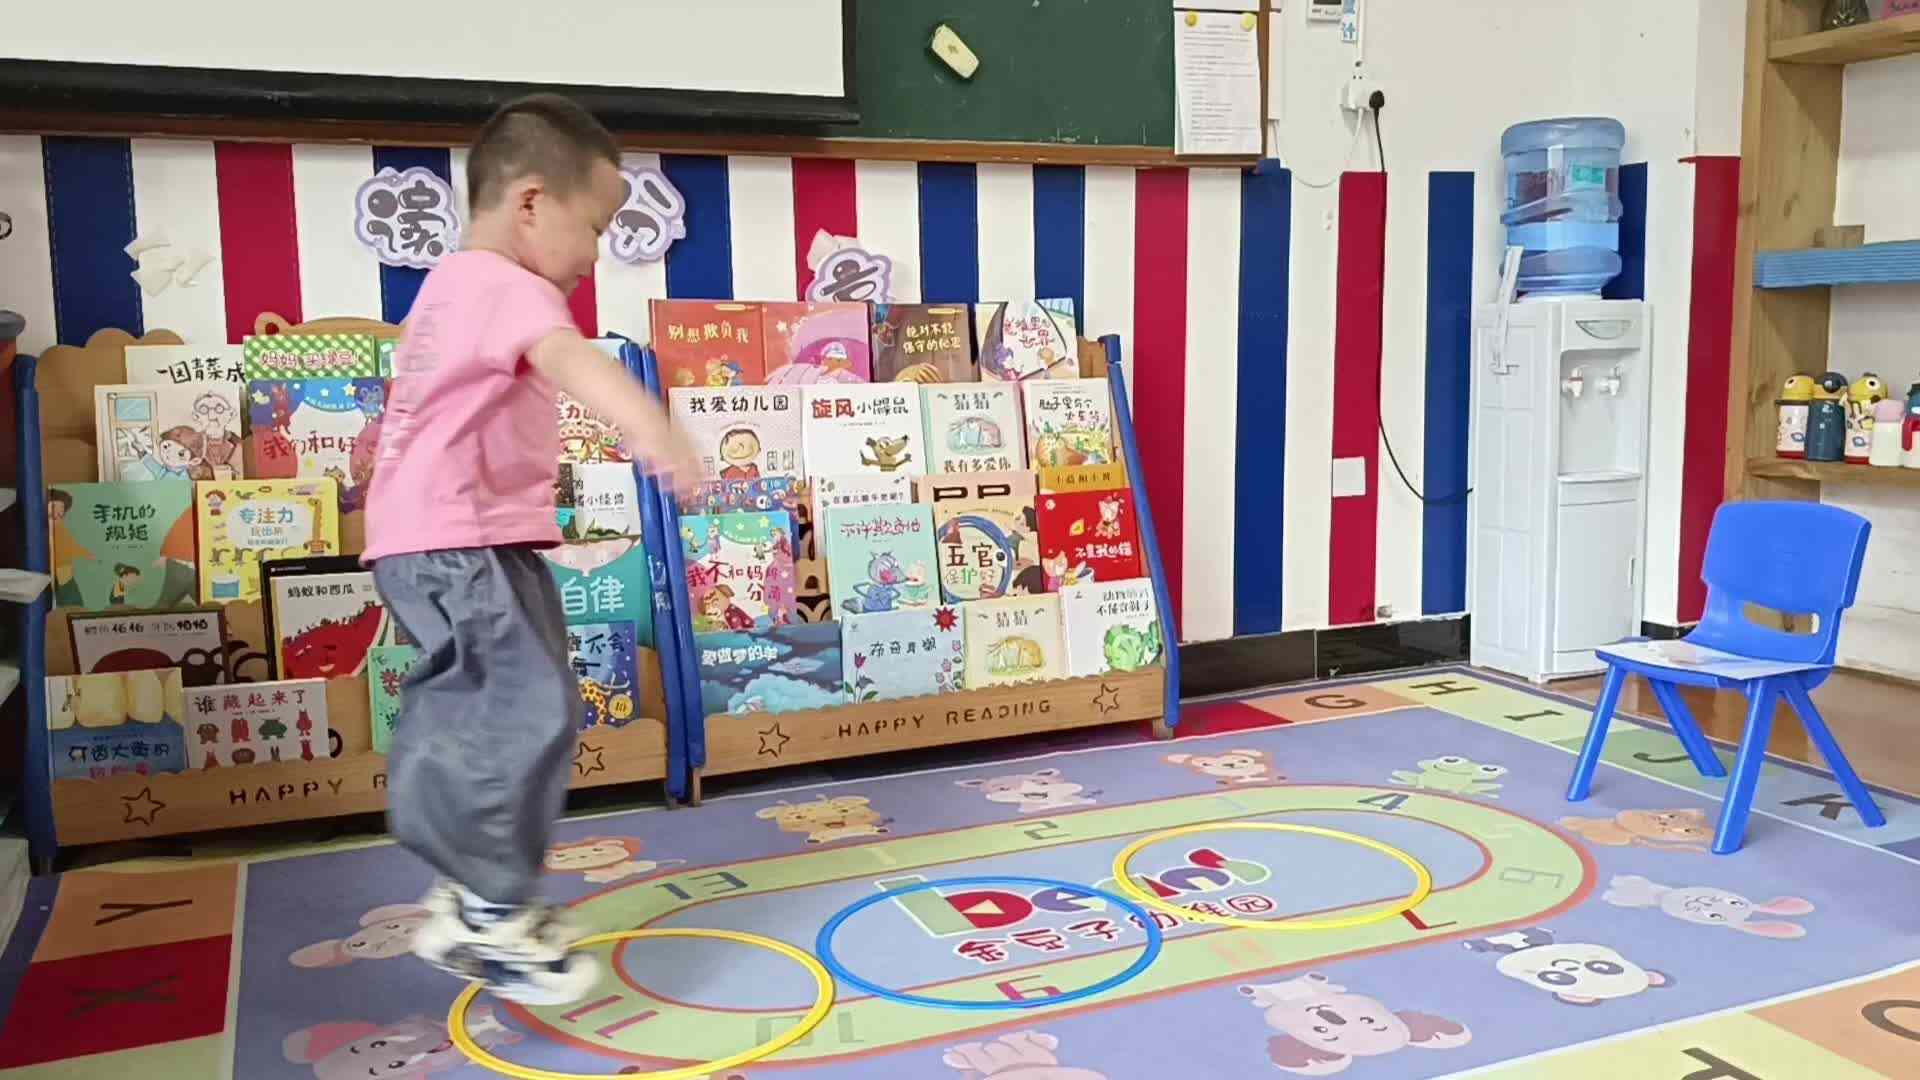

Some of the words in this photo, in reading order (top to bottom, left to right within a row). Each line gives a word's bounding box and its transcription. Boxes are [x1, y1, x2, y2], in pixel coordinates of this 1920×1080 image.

[668, 320, 749, 344] 别想欺负我
[689, 394, 789, 413] 我爱幼儿园
[811, 396, 909, 418] 旋风小鼹鼠
[264, 430, 374, 458] 我们和好
[944, 457, 1012, 473] 我有多爱你
[93, 504, 156, 523] 手机的
[240, 506, 293, 524] 专注力
[105, 524, 149, 542] 规矩
[946, 542, 993, 567] 五官
[687, 560, 779, 587] 我不和妈妈
[287, 582, 356, 599] 蚂蚁和西瓜
[560, 576, 626, 615] 自律
[193, 689, 306, 714] 谁藏起来了
[1303, 693, 1368, 710] G
[838, 714, 925, 738] HAPPY
[945, 700, 1051, 726] READING
[229, 777, 344, 806] HAPPY
[92, 899, 193, 927] Y
